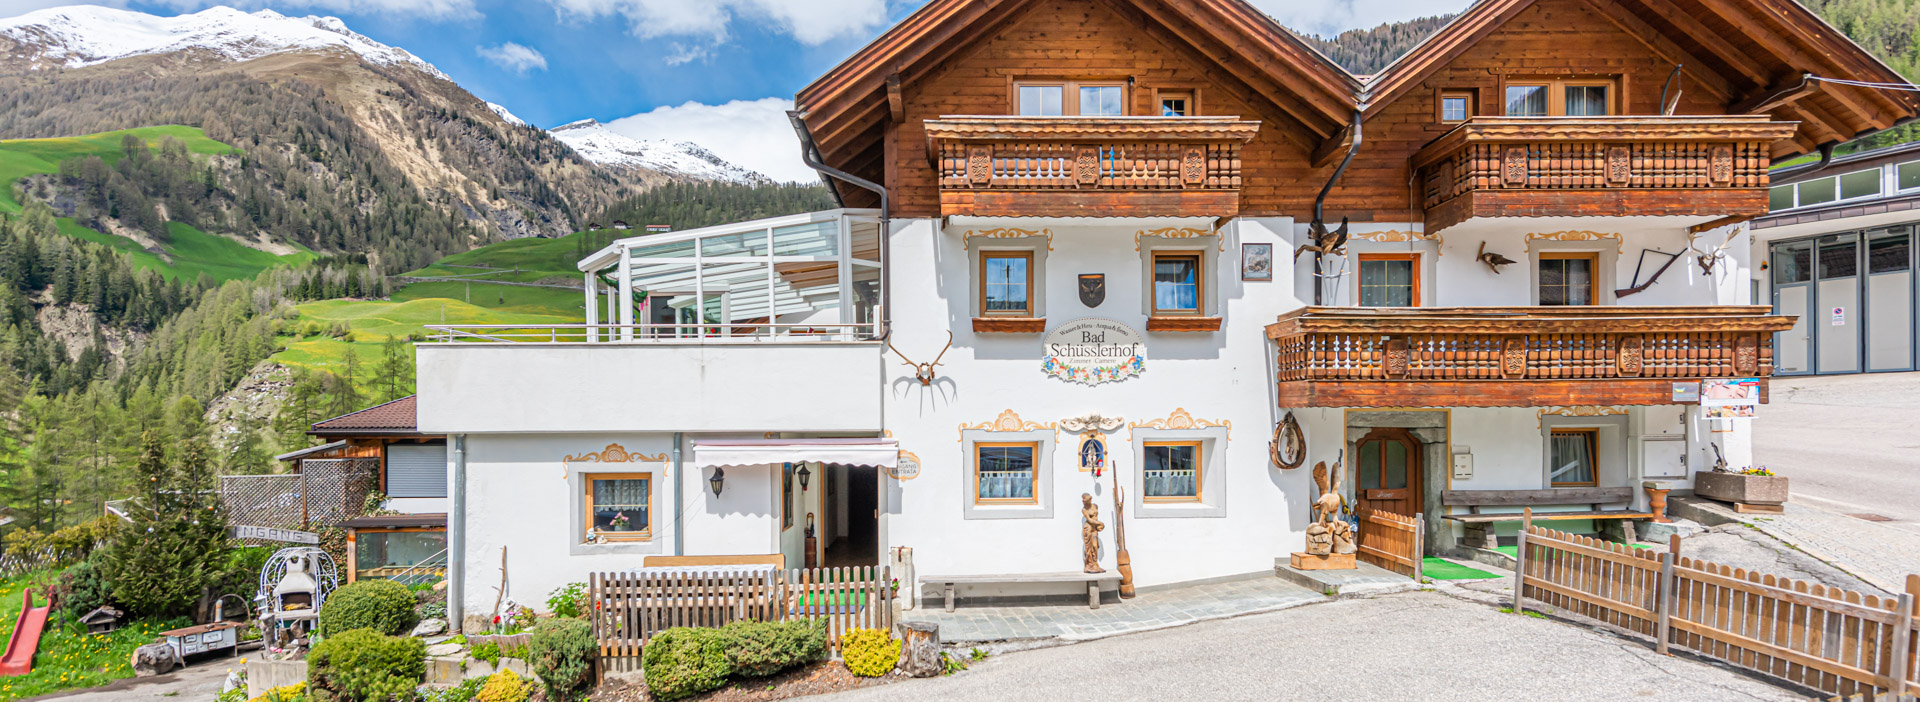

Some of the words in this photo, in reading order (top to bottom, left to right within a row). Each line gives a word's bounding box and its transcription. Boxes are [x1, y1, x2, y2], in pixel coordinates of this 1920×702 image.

[1082, 331, 1105, 343] Bad
[1051, 342, 1139, 357] Schüsslerhof
[233, 525, 303, 542] INGANG
